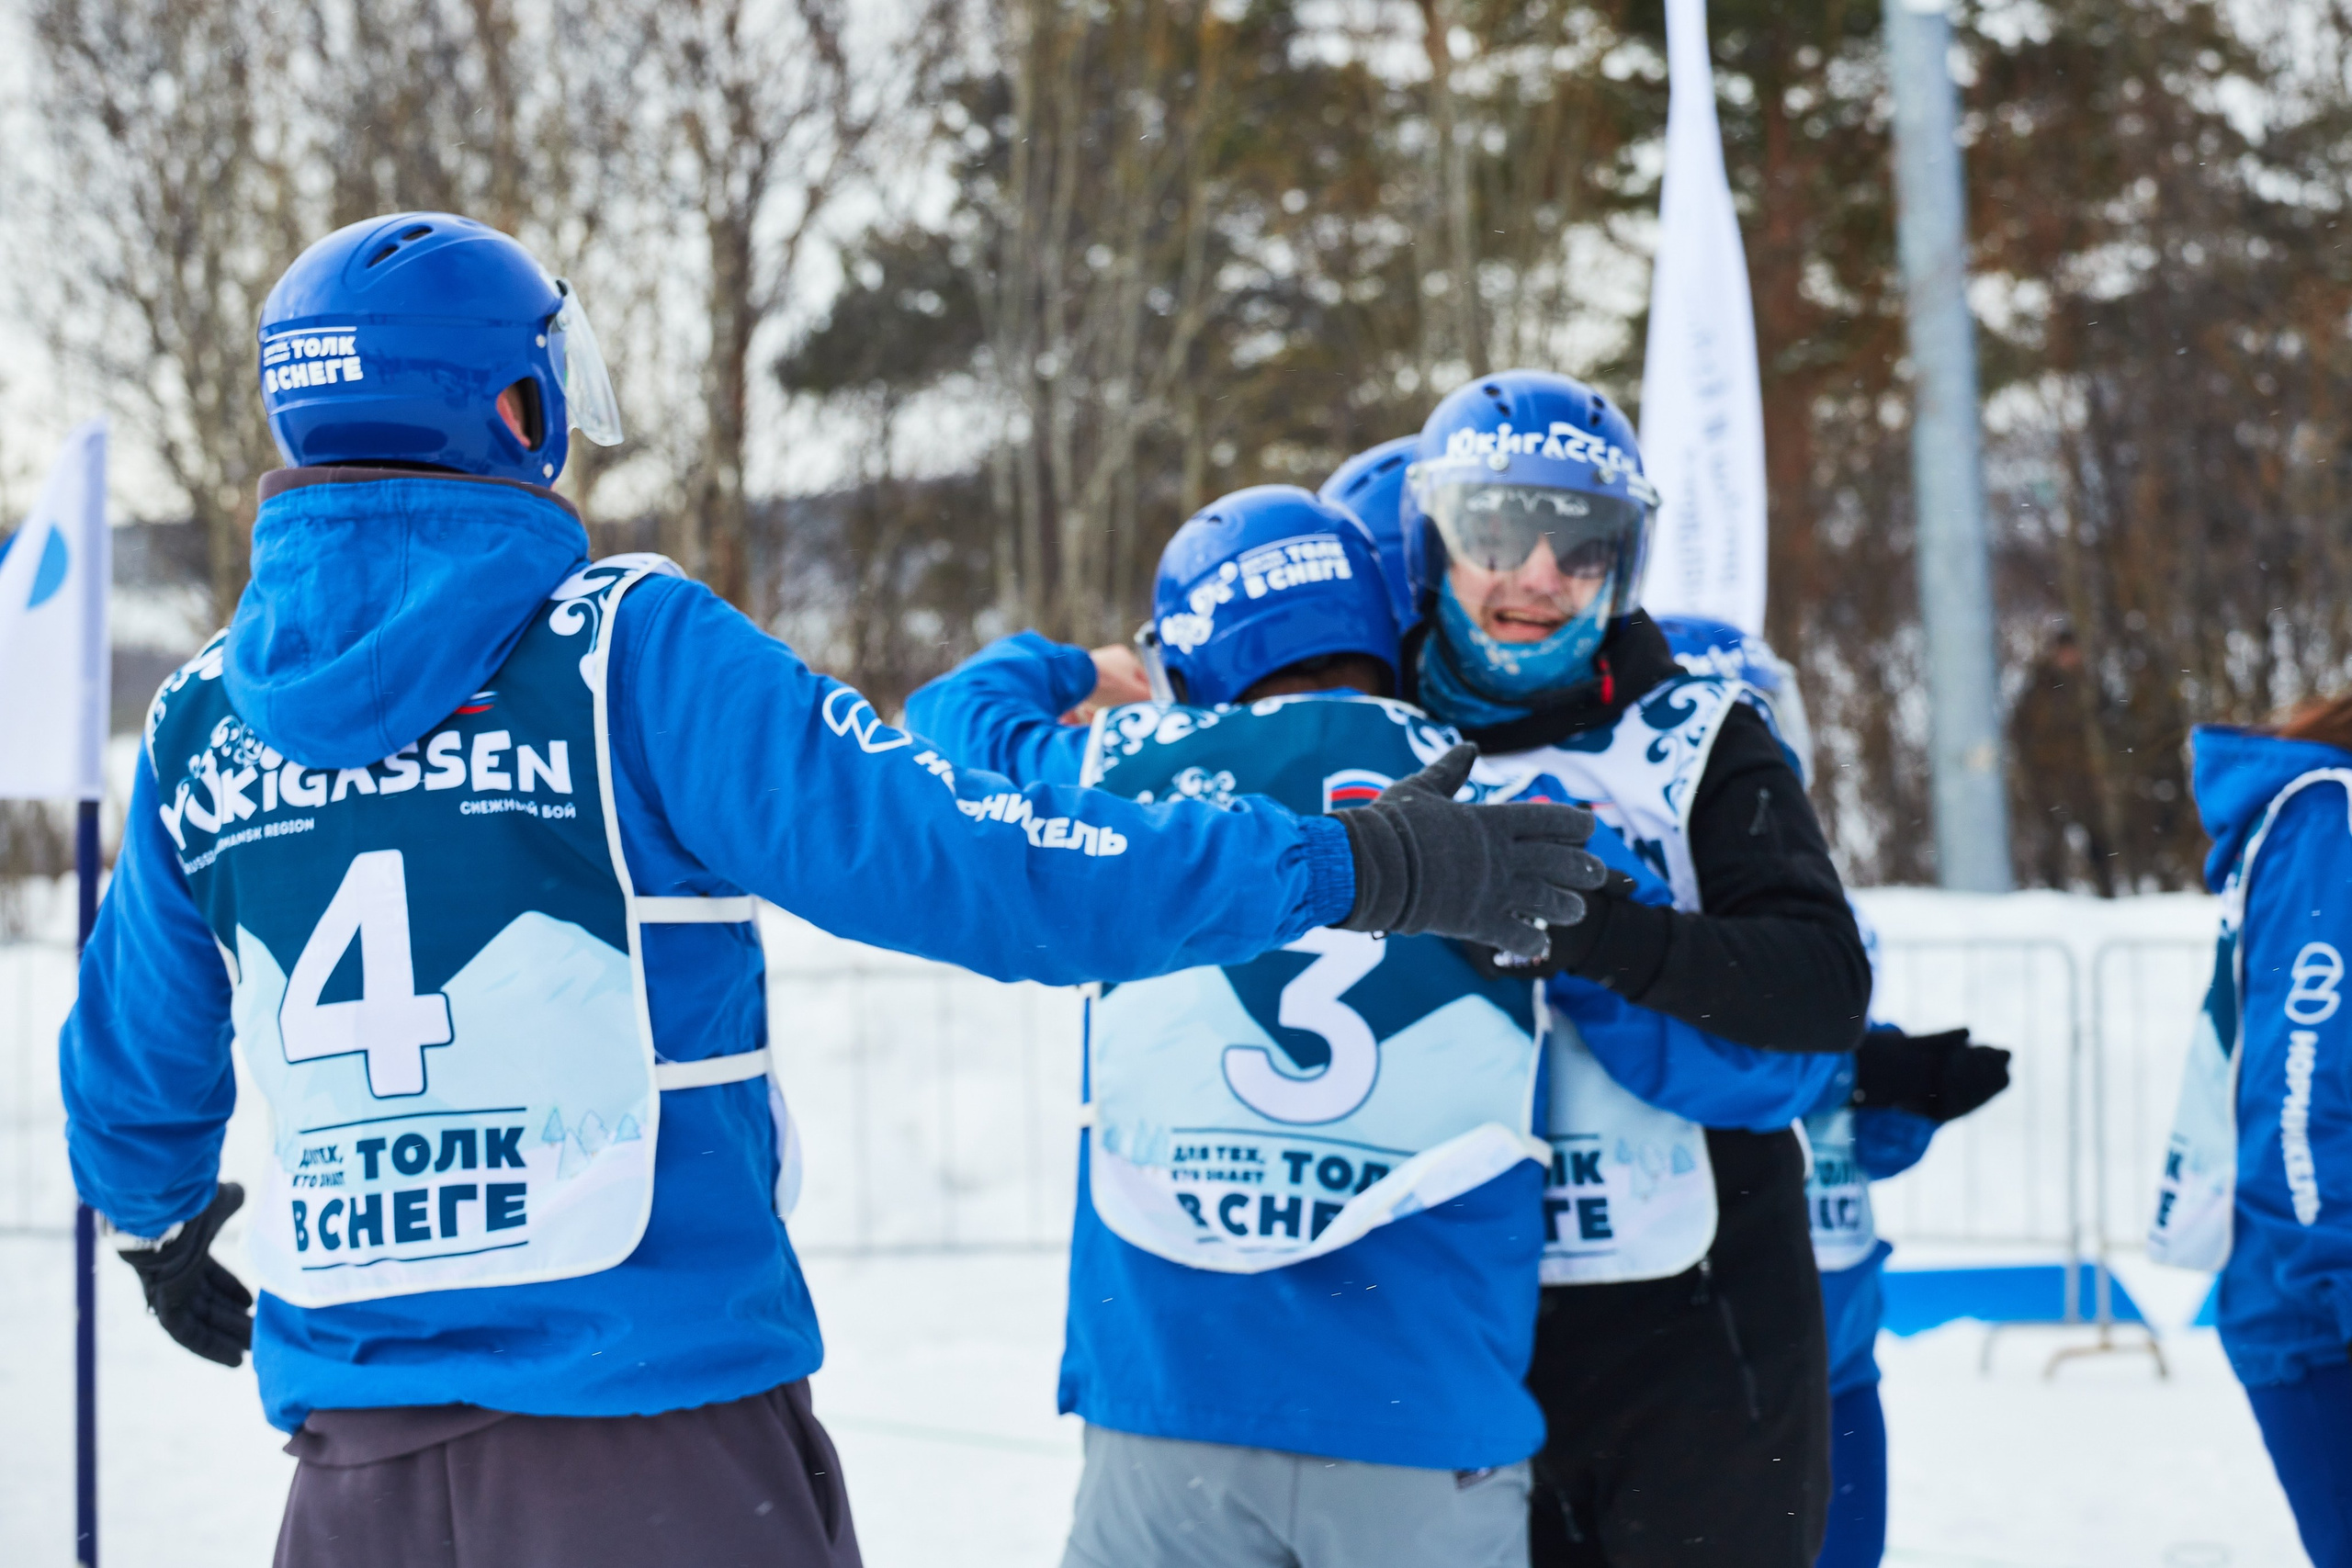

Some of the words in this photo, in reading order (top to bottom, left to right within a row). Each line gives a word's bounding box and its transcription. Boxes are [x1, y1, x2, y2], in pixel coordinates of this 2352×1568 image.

[291, 335, 356, 359] ТОЛК
[278, 355, 364, 390] СНЕГЕ
[263, 817, 315, 839] REGION
[541, 801, 577, 819] БОЙ
[278, 849, 455, 1099] 4
[1222, 925, 1386, 1126] 3
[356, 1126, 527, 1180] ТОЛК
[1282, 1150, 1389, 1195] ТОЛ
[291, 1200, 310, 1253] В
[317, 1182, 527, 1251] СНЕГЕ
[1218, 1192, 1344, 1242] СНЕ
